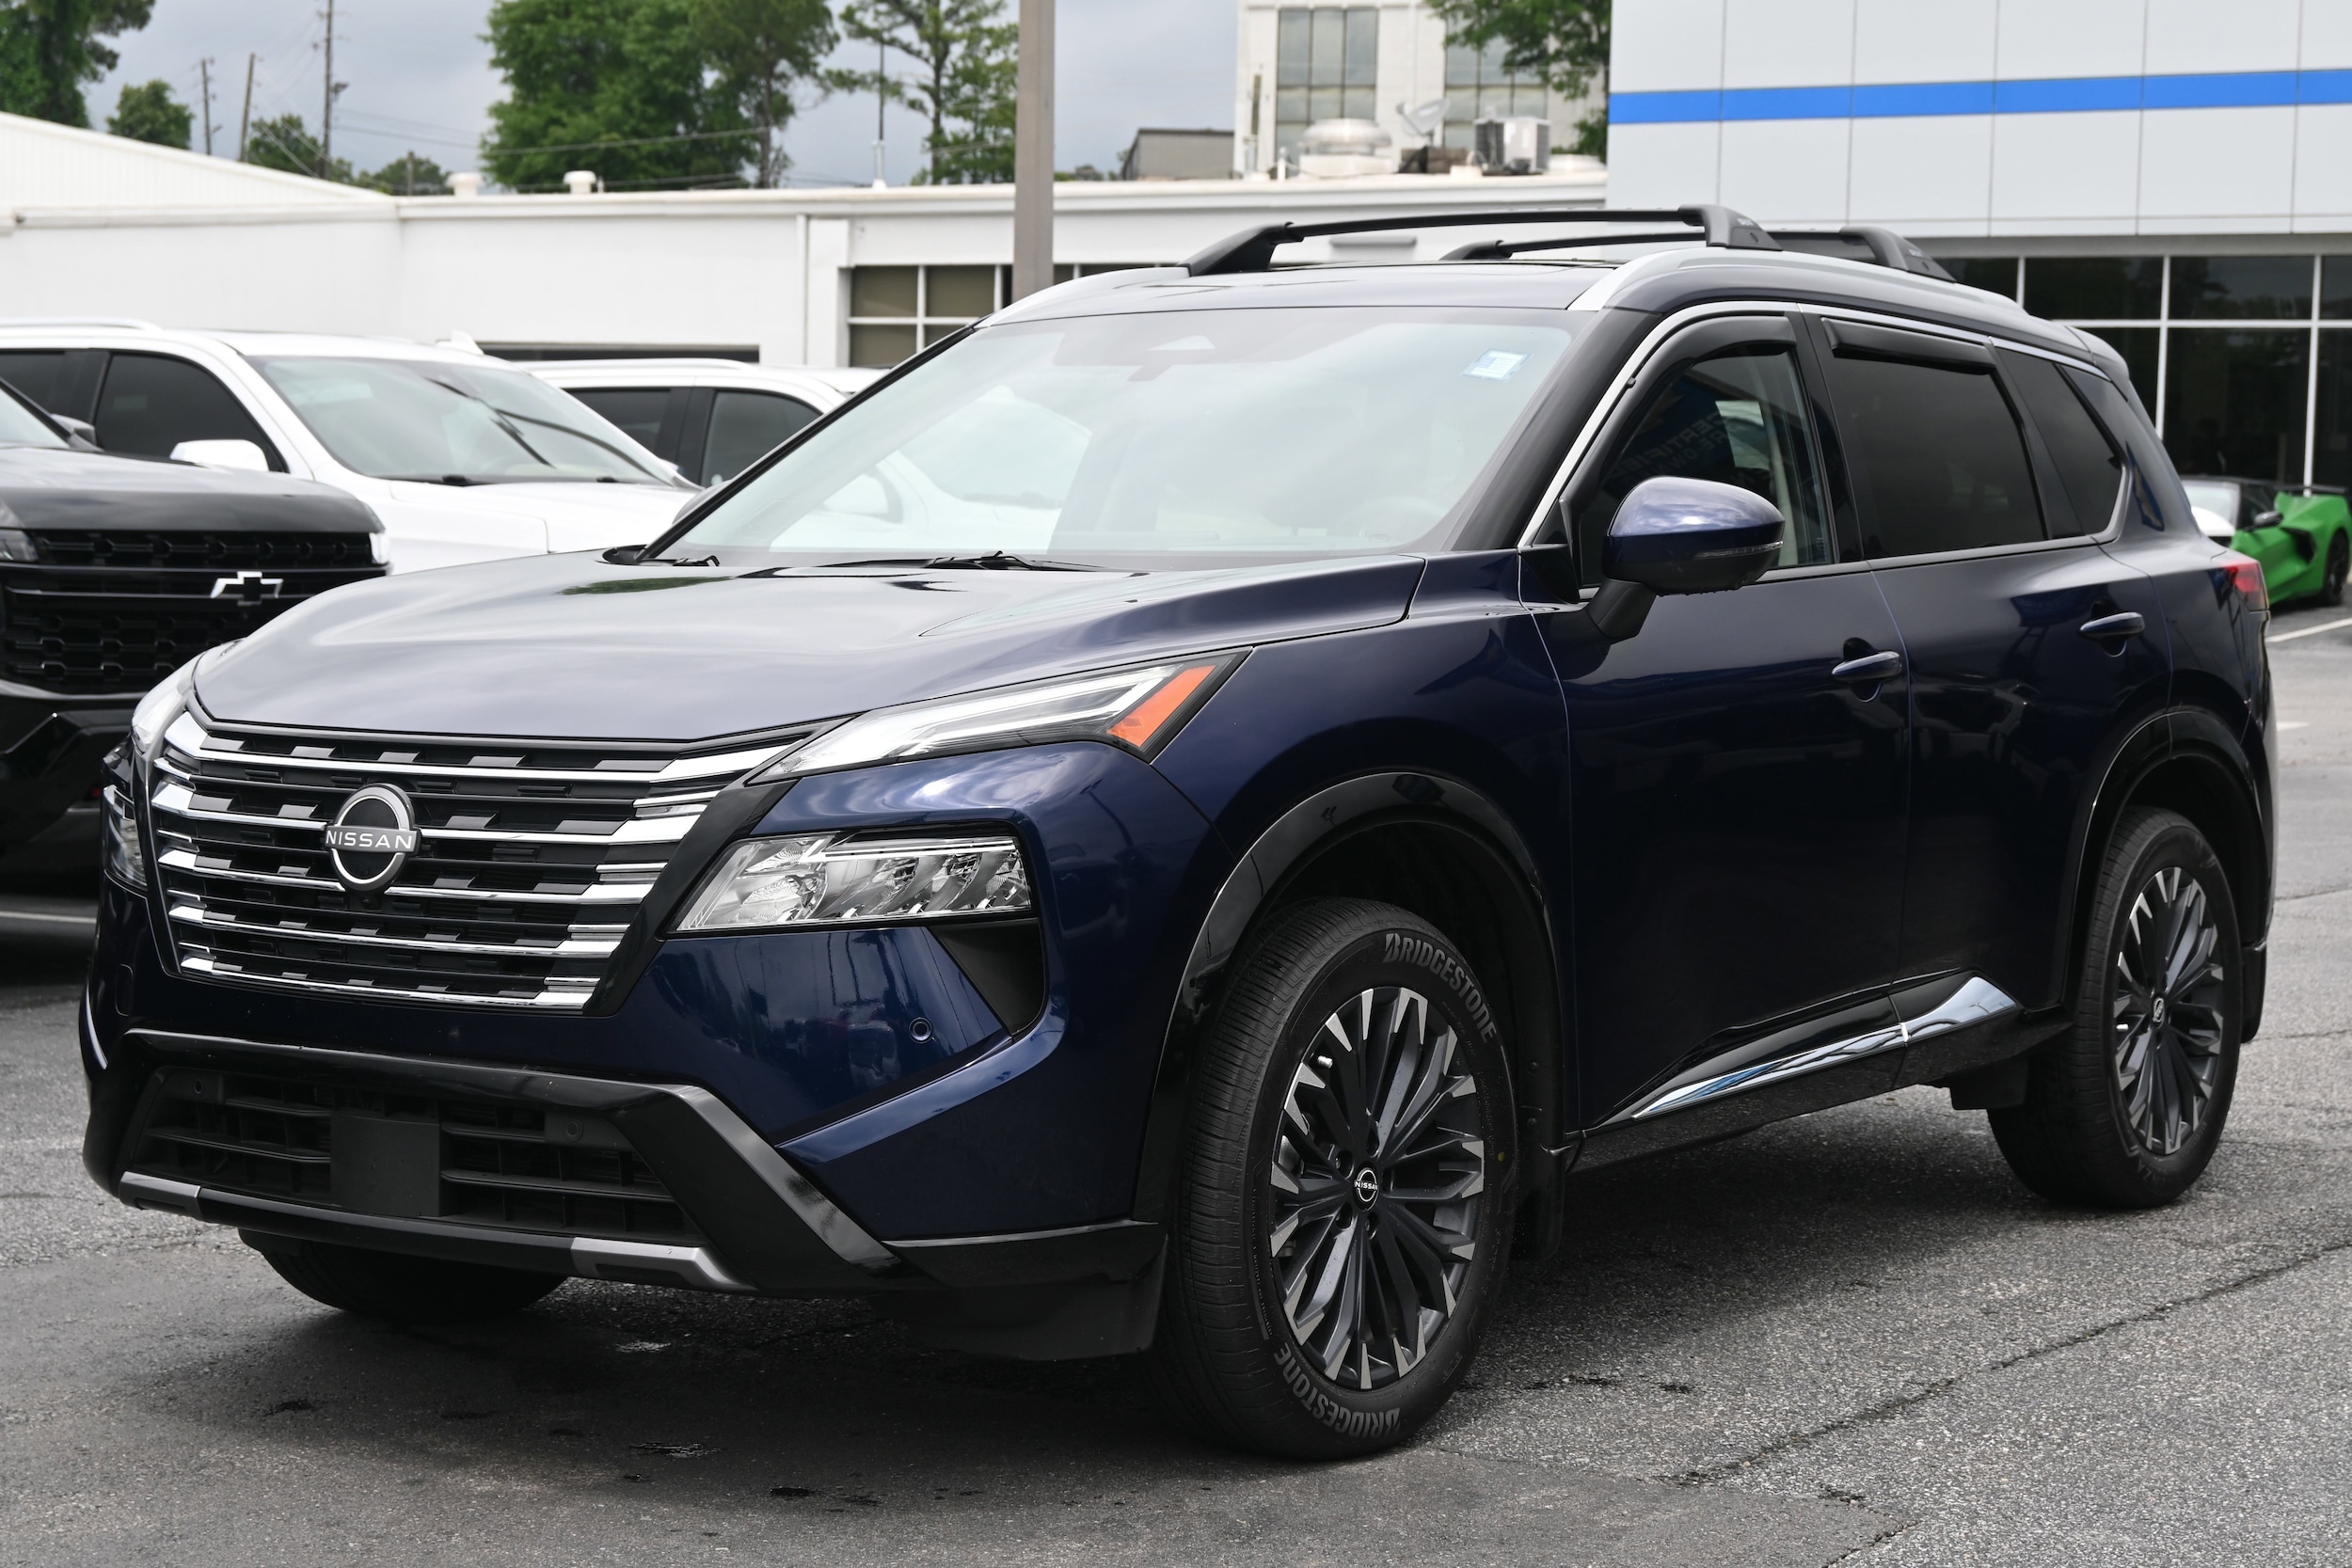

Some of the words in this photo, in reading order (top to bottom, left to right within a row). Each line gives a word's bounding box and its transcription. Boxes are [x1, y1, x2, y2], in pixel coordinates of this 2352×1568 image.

[326, 830, 412, 849] NISSAN
[1382, 932, 1498, 1043] BRIDGESTONE
[1274, 1342, 1400, 1439] BRIDGESTONE
